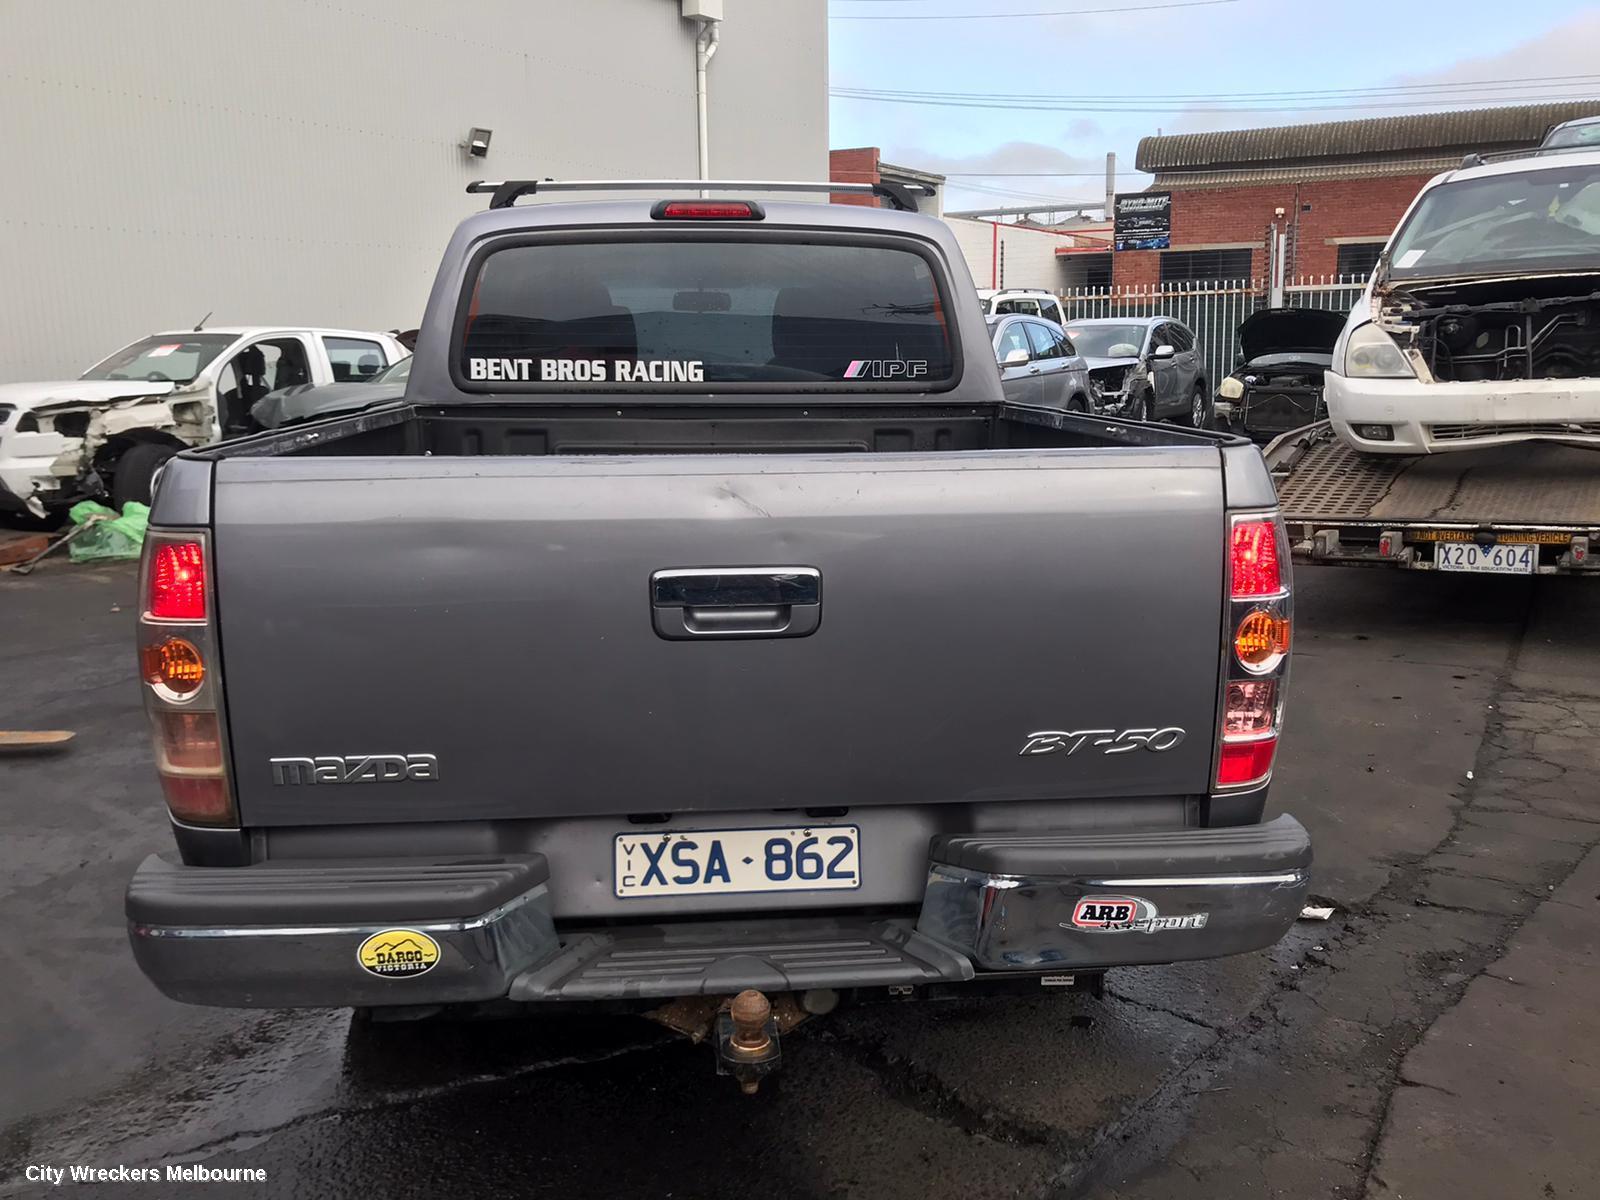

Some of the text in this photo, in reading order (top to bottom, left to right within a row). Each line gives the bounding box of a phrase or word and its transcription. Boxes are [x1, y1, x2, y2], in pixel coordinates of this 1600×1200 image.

[469, 358, 704, 382] BENT BROS RACING
[1536, 532, 1568, 543] VEHICLE
[1442, 547, 1530, 567] X20 604
[1019, 727, 1186, 756] BT-50
[640, 836, 855, 887] XSA 862
[1080, 905, 1130, 921] ARB
[376, 950, 424, 964] DARGO
[375, 963, 427, 972] VICTORIA
